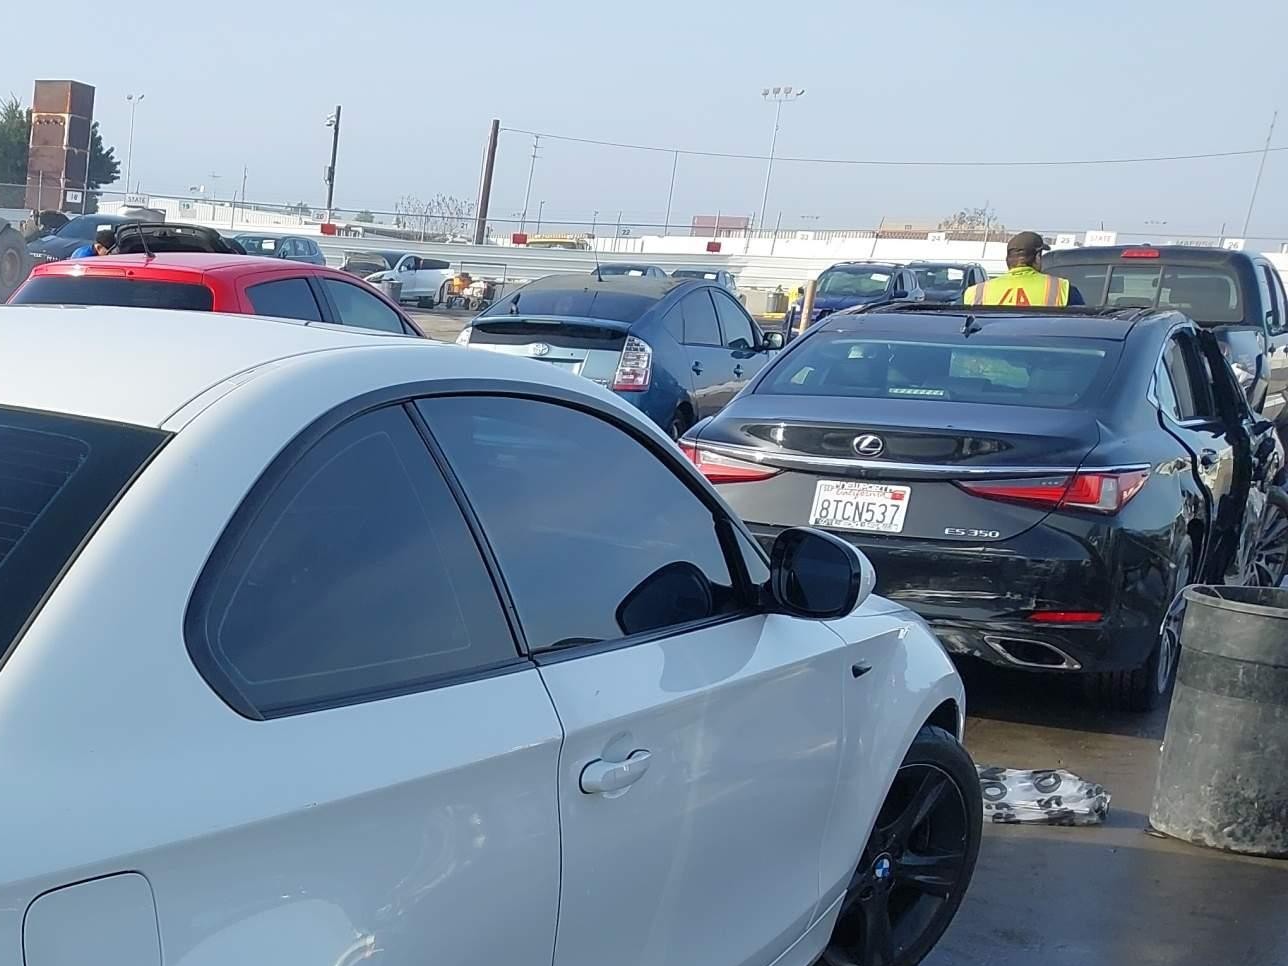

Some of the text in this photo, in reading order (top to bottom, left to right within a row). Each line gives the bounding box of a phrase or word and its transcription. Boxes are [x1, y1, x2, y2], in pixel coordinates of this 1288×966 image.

[127, 196, 146, 204] STATE
[1228, 241, 1239, 249] 26
[819, 499, 901, 525] 8TCN537
[944, 527, 1001, 539] ES 350
